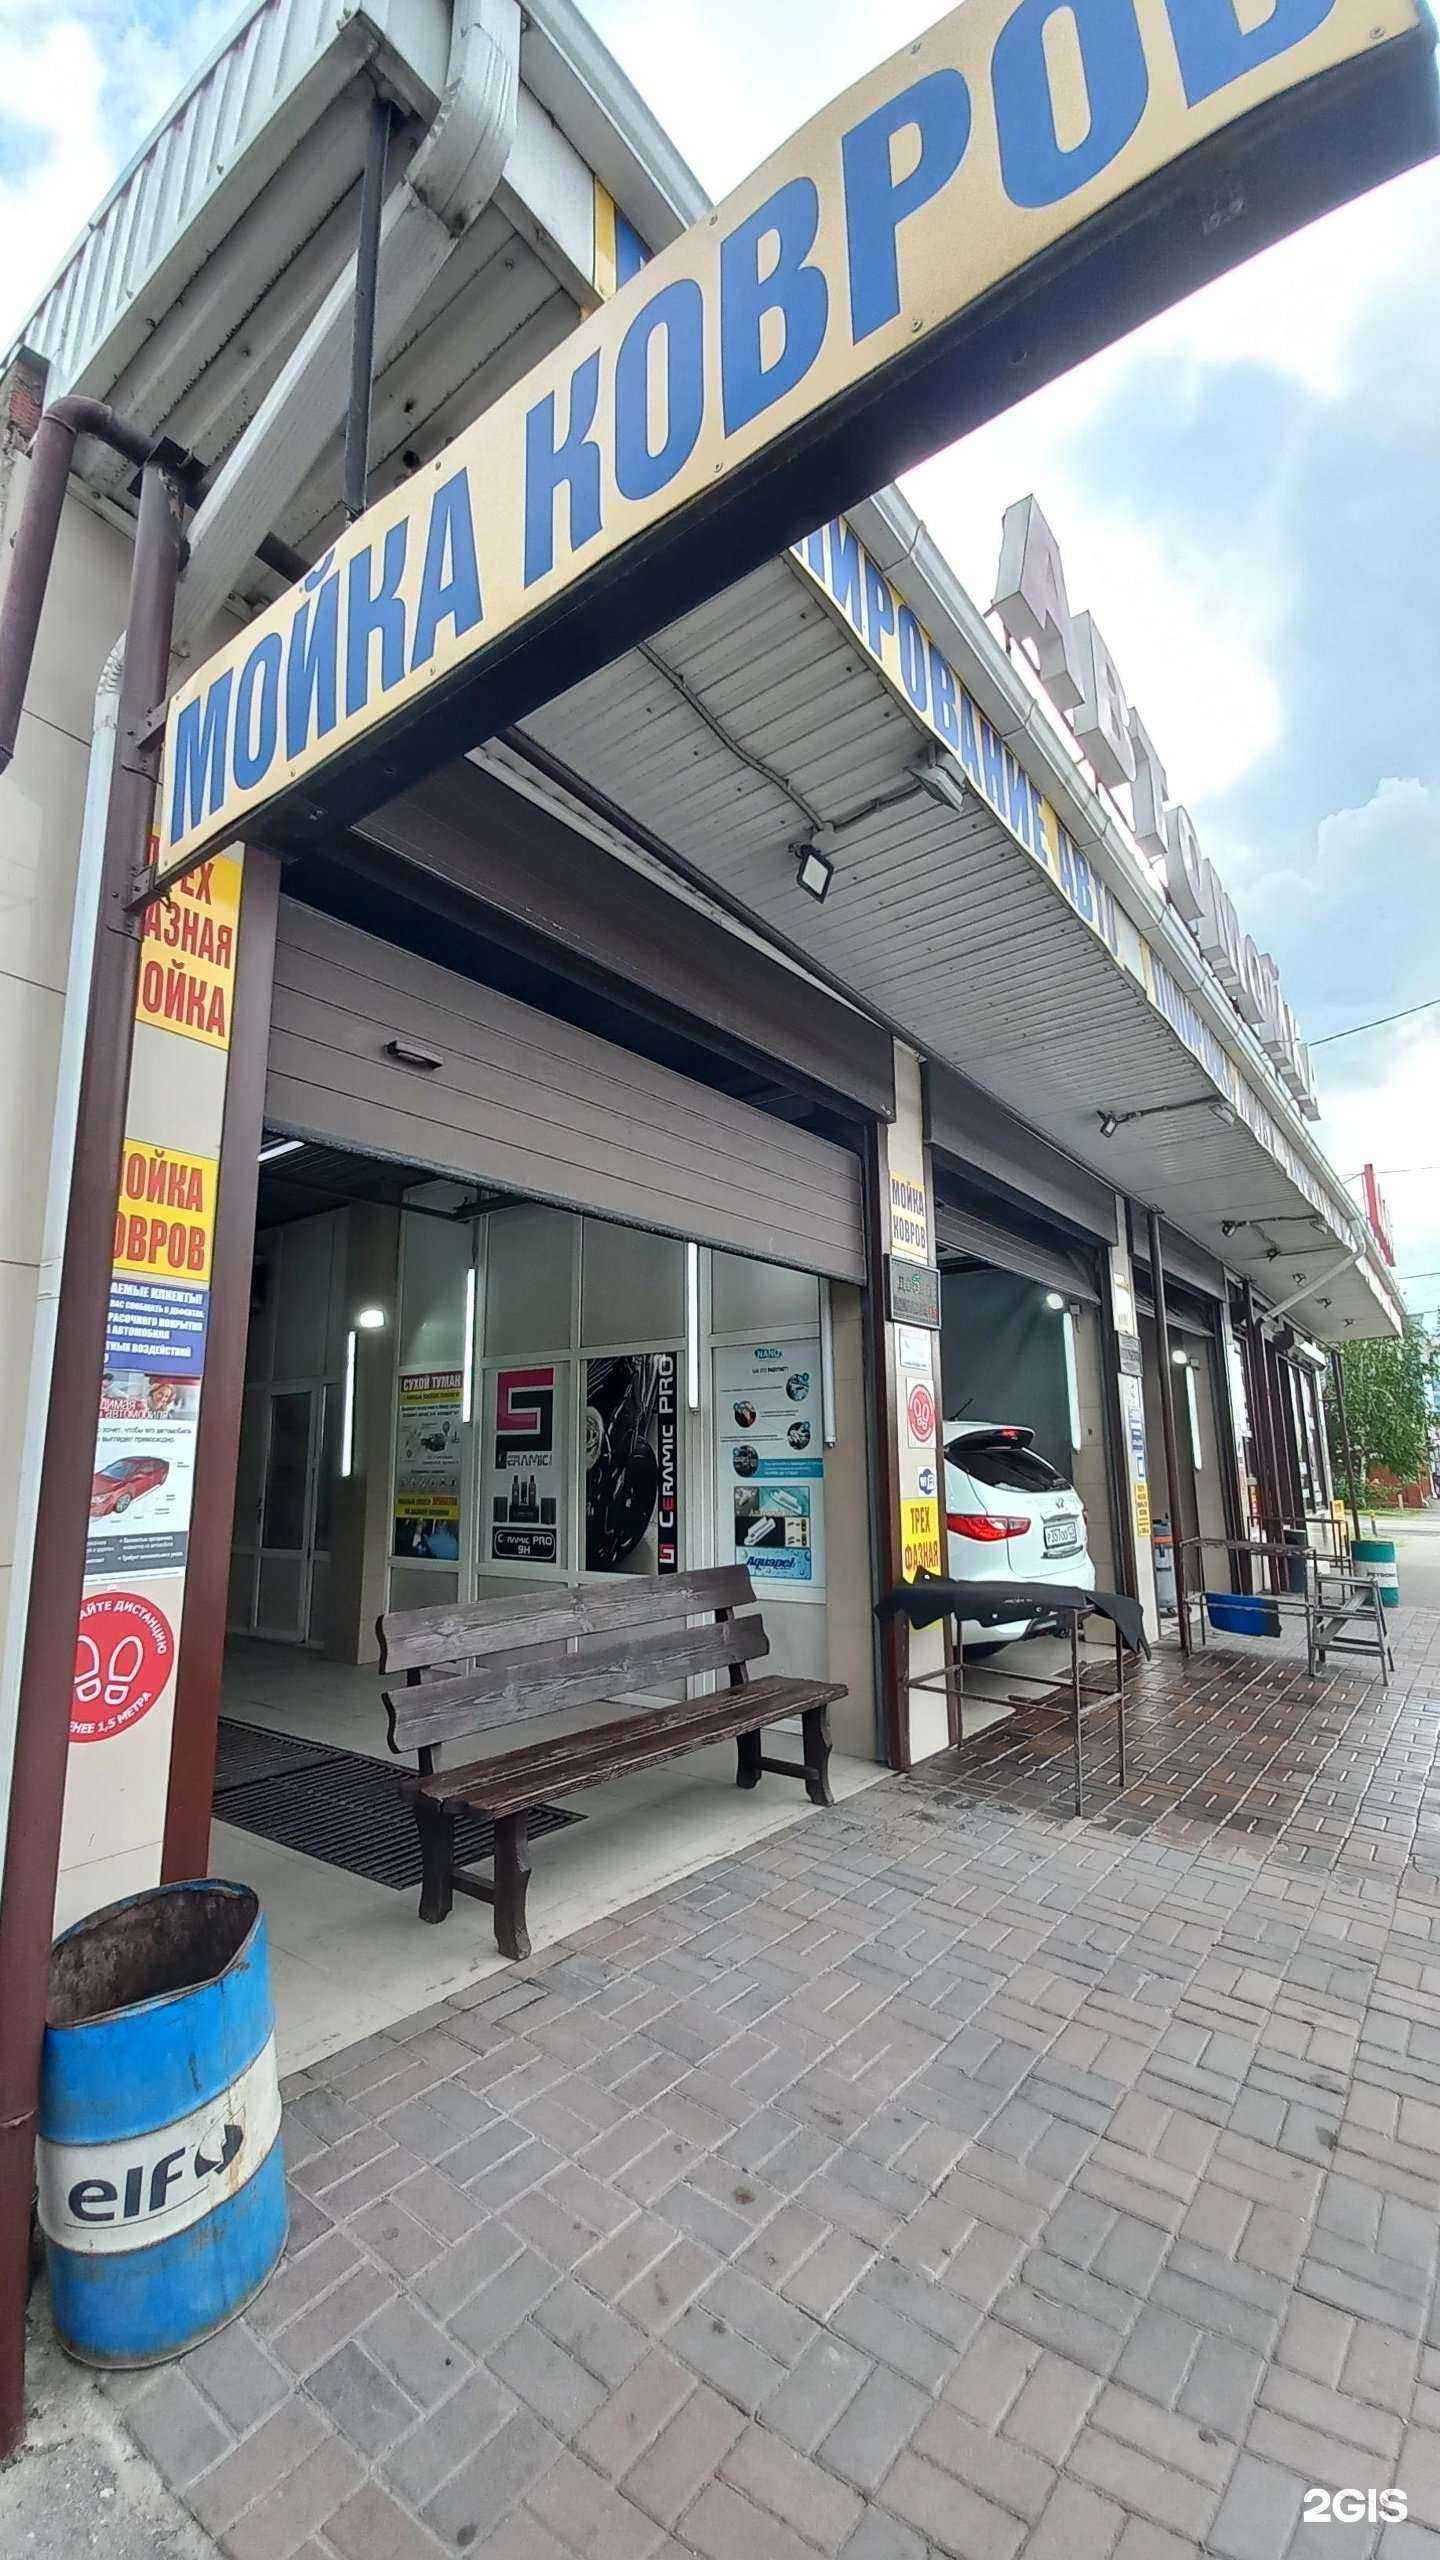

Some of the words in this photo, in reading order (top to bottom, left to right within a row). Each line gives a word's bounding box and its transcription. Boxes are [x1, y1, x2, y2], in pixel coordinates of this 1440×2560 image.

[169, 467, 484, 846] МОЙКА
[142, 900, 233, 970] АЗНАЯ
[142, 958, 225, 1038] ОЙКА
[121, 1149, 203, 1213] ОЙКА
[892, 1178, 925, 1217] МОЙКА
[112, 1210, 206, 1271] ОВРОВ
[893, 1215, 926, 1249] КОВРОВ
[110, 1282, 150, 1298] АЕМЫЕ
[108, 1312, 158, 1327] РАСОЧНОГО
[403, 1375, 430, 1392] СУХОЙ
[431, 1373, 461, 1390] ТУМАН
[658, 1354, 674, 1414] PRO
[100, 1399, 137, 1411] димая
[497, 1452, 549, 1468] ERAMIC
[659, 1424, 674, 1529] CERAMIC
[497, 1533, 531, 1545] CRAMIC
[532, 1534, 553, 1546] PRO
[910, 1506, 931, 1534] ТРЕХ
[904, 1541, 938, 1571] ФАЗНАЯ
[79, 1600, 112, 1621] АЙТЕ
[114, 1600, 167, 1655] ДИСТАНЦИЮ
[70, 1720, 96, 1734] ЕНЕЕ
[97, 1717, 116, 1733] 1,5
[116, 1691, 153, 1724] МЕТРА
[67, 2147, 186, 2224] elf
